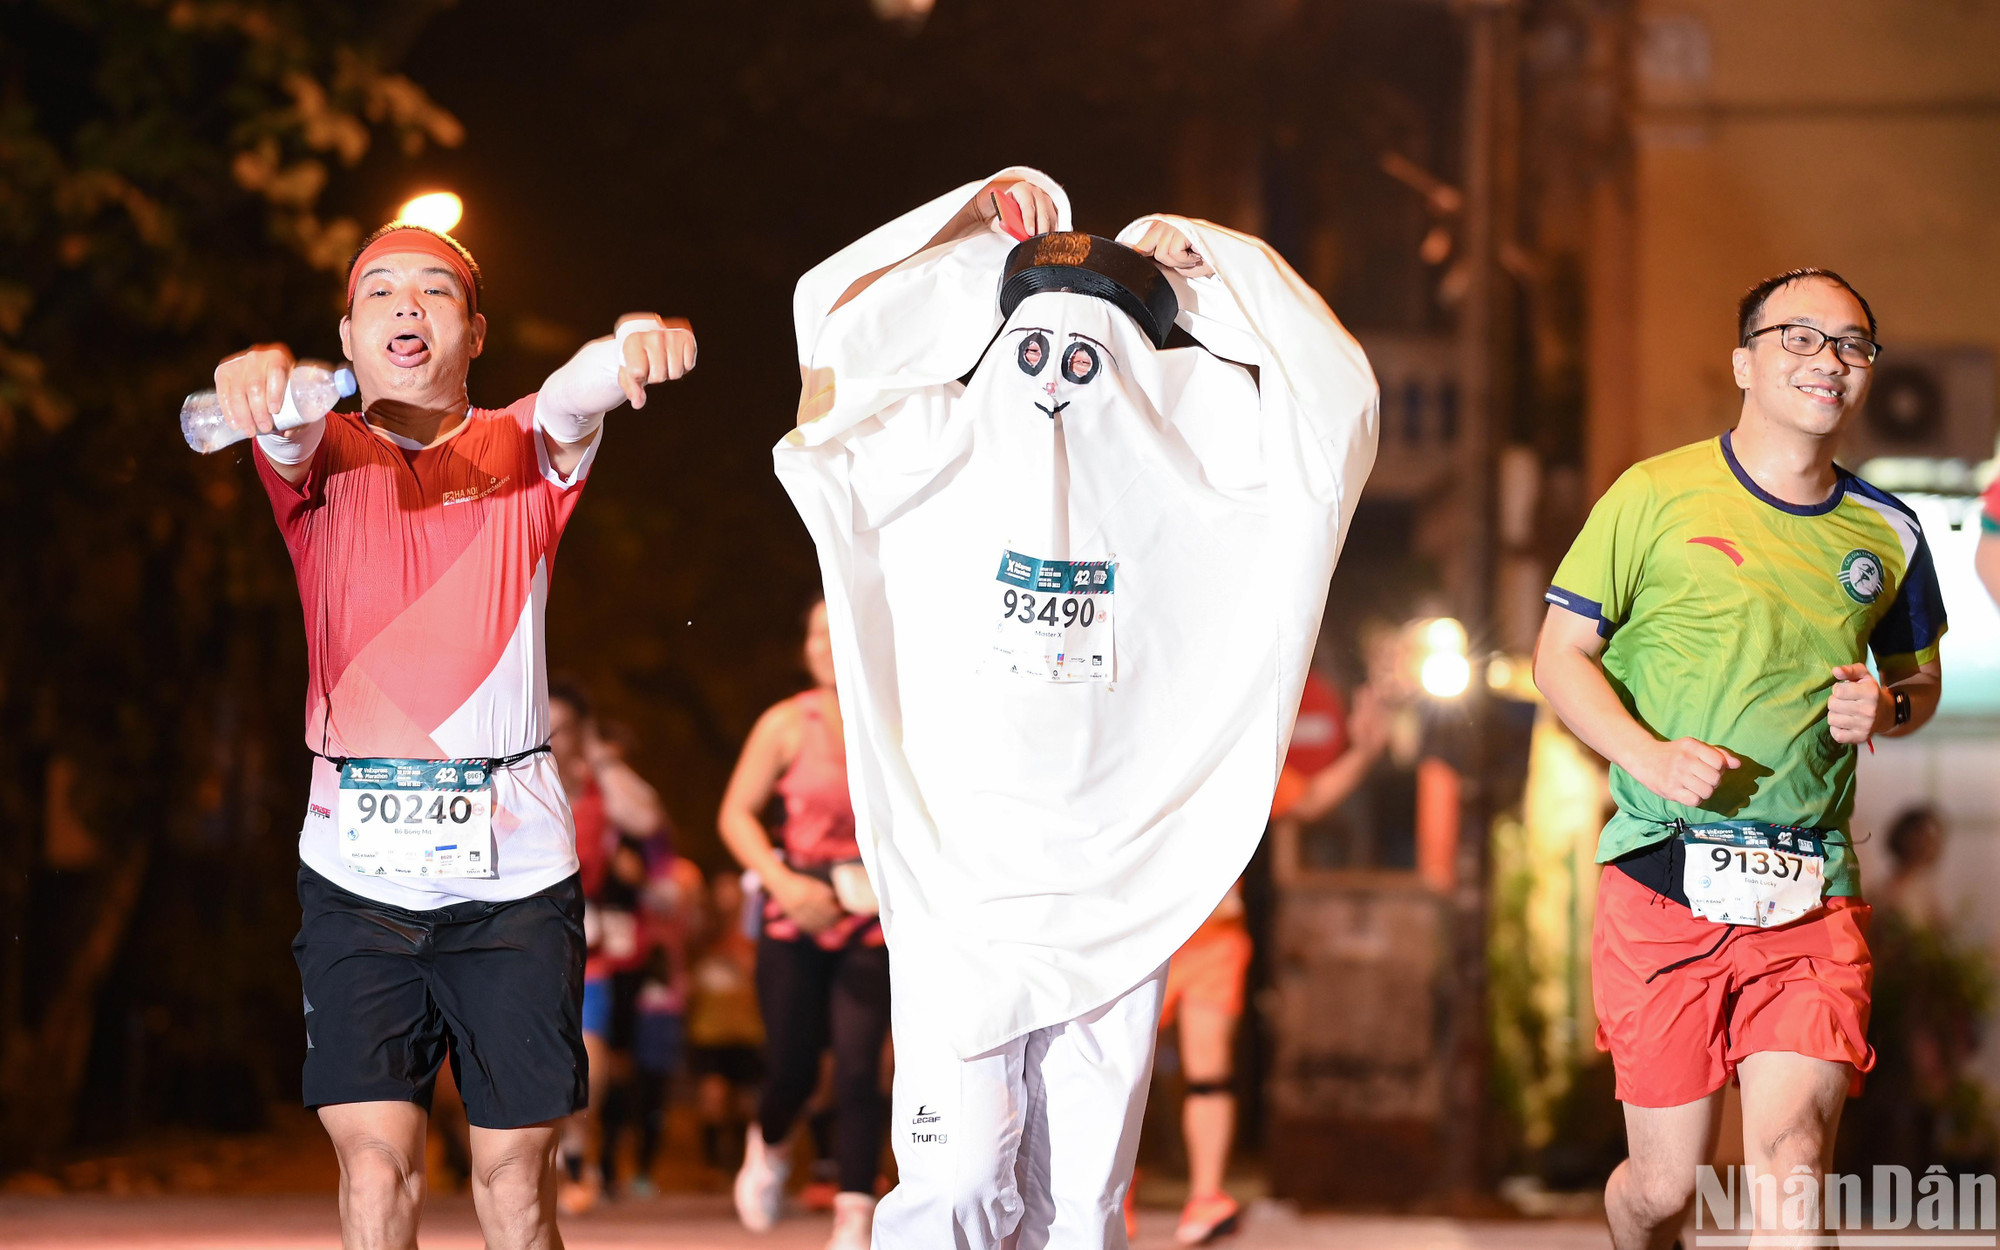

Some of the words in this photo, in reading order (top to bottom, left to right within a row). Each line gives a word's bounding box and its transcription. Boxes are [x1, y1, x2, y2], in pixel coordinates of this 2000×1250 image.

[1003, 589, 1095, 629] 93490
[434, 767, 457, 784] 42
[357, 793, 472, 825] 90240
[1710, 847, 1803, 882] 91337
[911, 1132, 948, 1145] Trung
